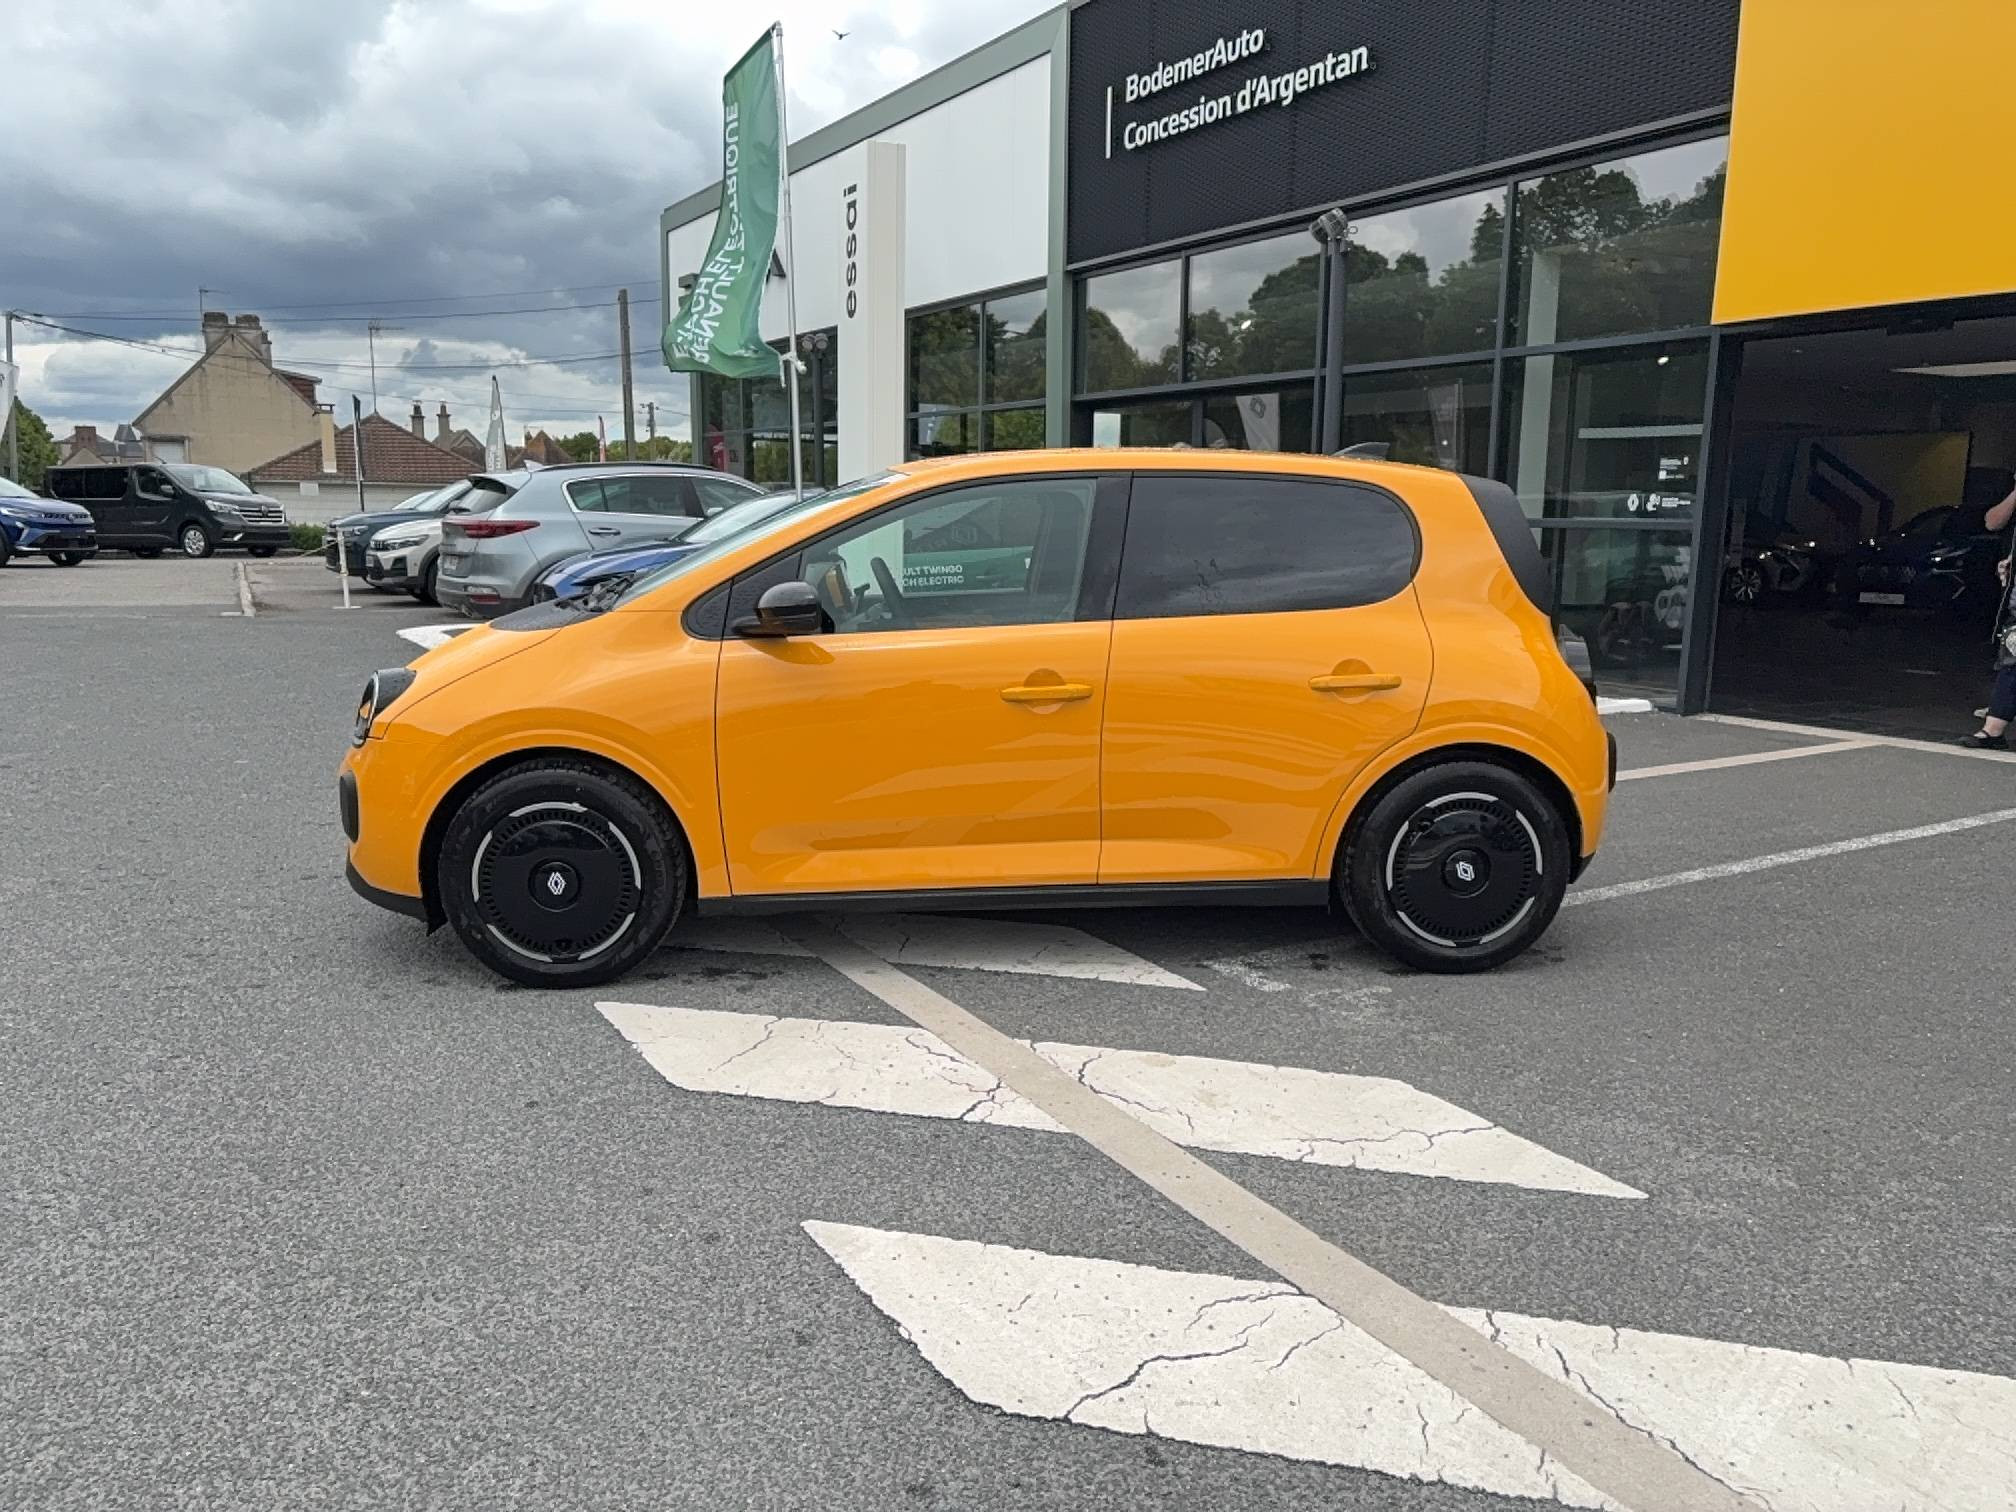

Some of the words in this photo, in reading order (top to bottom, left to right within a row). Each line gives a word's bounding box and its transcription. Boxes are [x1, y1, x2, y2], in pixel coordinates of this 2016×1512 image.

[1124, 96, 1232, 150] Concession
[1235, 45, 1369, 115] d'Argentan
[1126, 28, 1264, 103] BodemerAuto
[844, 184, 857, 319] essai
[918, 576, 964, 585] ELECTRIC
[923, 565, 962, 575] TWINGO
